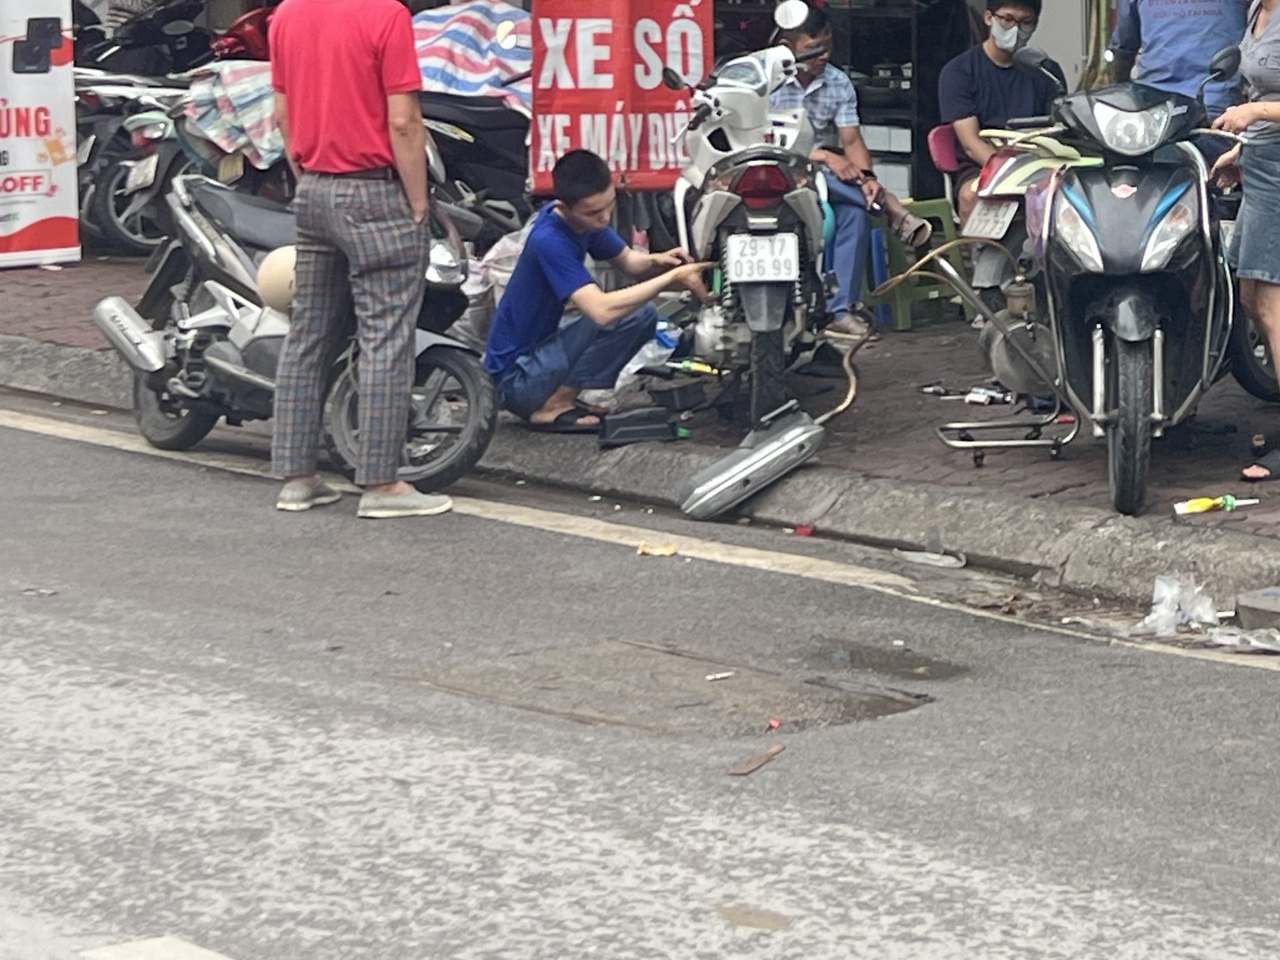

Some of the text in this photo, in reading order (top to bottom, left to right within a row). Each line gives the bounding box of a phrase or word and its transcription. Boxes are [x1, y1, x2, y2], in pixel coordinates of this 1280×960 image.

[537, 18, 614, 89] XE
[537, 114, 571, 172] XE
[580, 101, 643, 171] MÁY
[0, 175, 44, 194] OFF
[734, 258, 792, 278] 036.99
